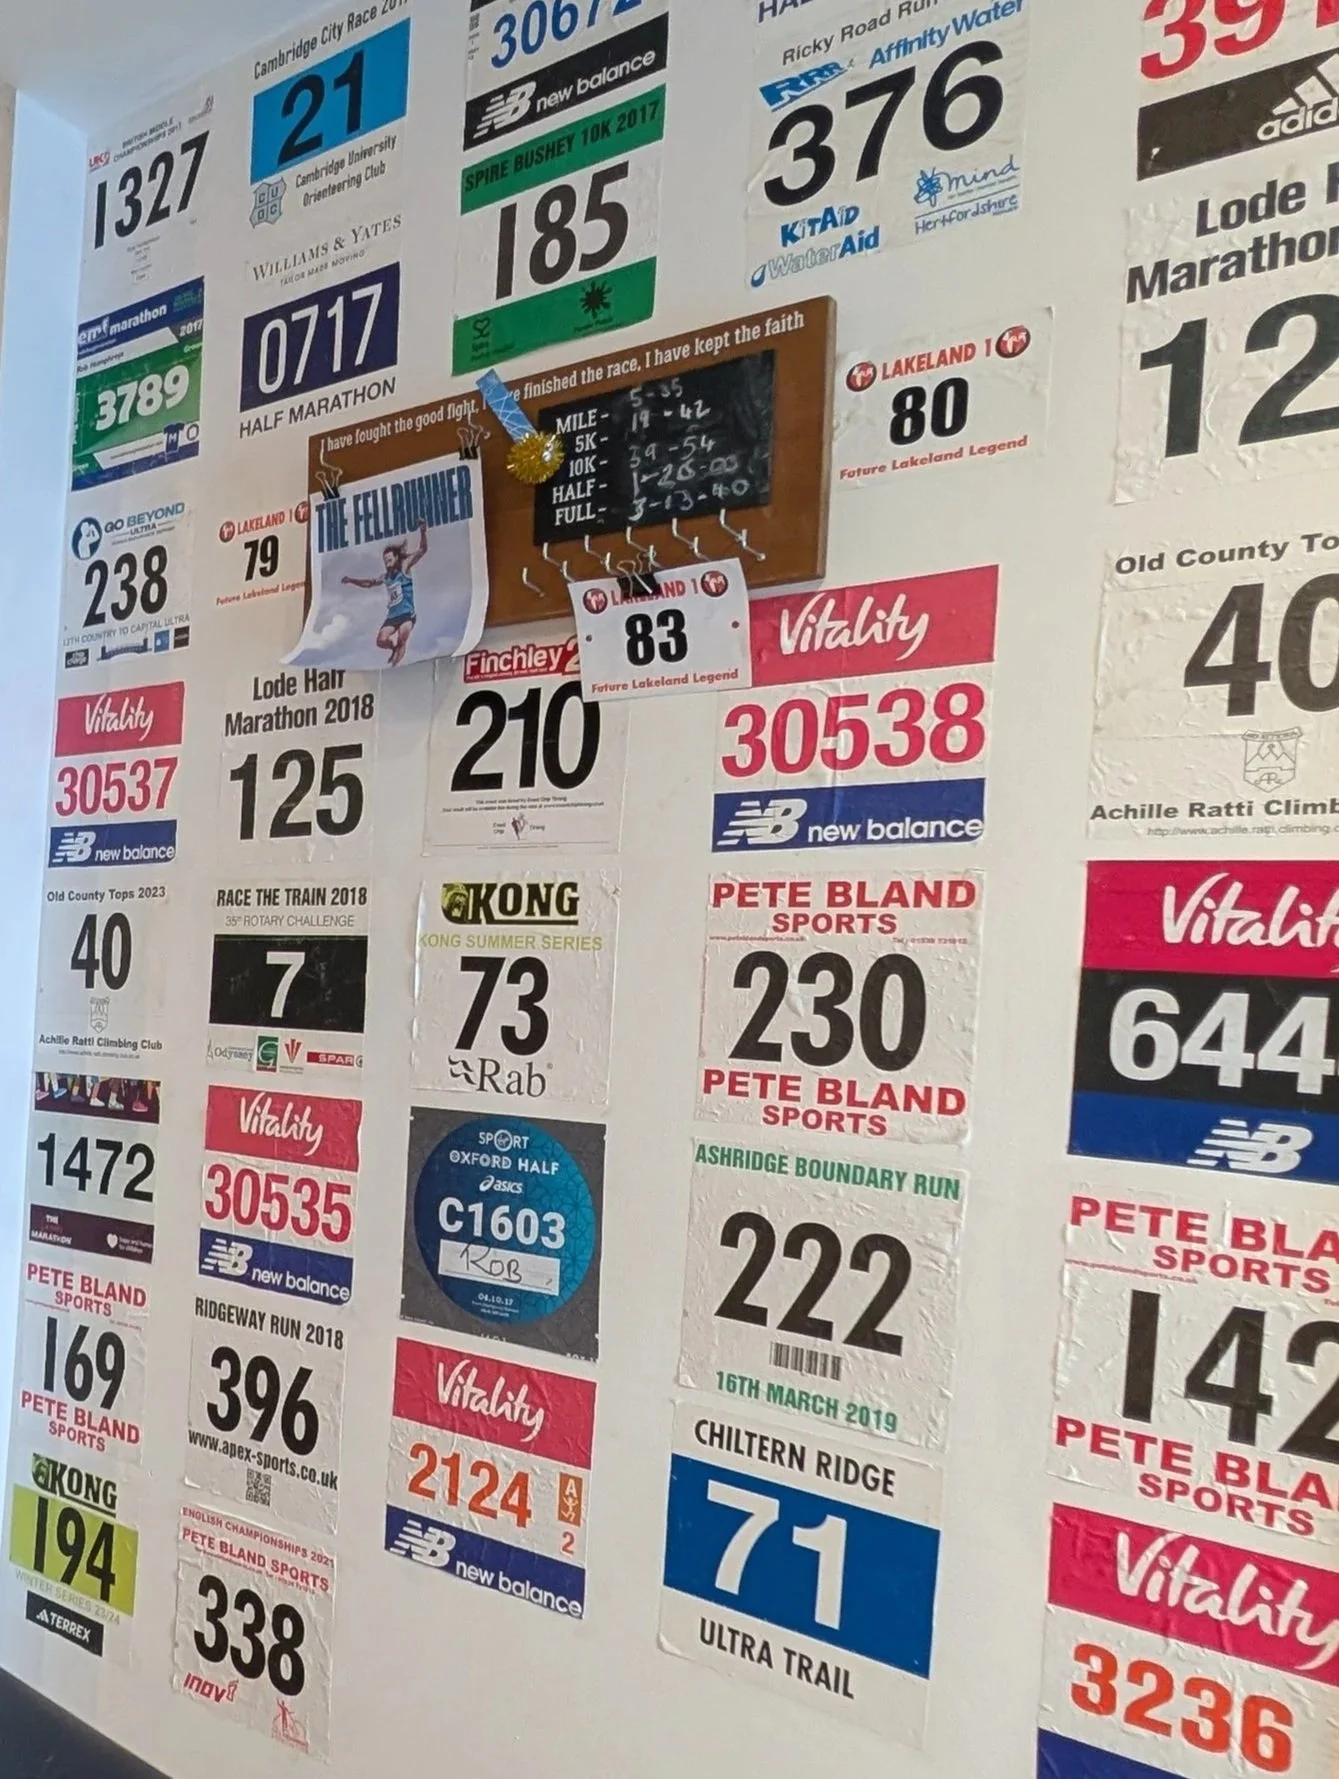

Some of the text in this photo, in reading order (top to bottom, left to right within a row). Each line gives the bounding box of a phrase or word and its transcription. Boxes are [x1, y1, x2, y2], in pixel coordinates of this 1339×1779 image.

[254, 6, 378, 80] Cambridge City Race
[782, 11, 890, 66] Ricky Road
[869, 24, 950, 69] Affinity
[277, 49, 364, 166] 21
[536, 51, 656, 112] new balance
[464, 102, 659, 193] SPIRE BUSHEY 10K 2017
[764, 40, 1004, 207] 376
[295, 133, 397, 189] Cambridge University
[303, 162, 386, 208] Orienteering Club
[946, 154, 1021, 191] mind
[93, 129, 210, 250] 1327
[914, 193, 1019, 236] Hertfordshire
[1196, 179, 1306, 238] Lode
[252, 214, 402, 282] WILLIAMS & YATES
[496, 160, 630, 300] 185
[279, 269, 305, 288] TAILOR
[109, 304, 167, 336] marathon
[179, 318, 203, 337] 2017
[258, 282, 383, 394] 0717
[327, 311, 805, 452] have fought the good fight, finished the race, have kept the faith
[882, 342, 977, 381] LAKELAND
[95, 364, 190, 432] 3789
[239, 376, 397, 439] HALF MARATHON
[890, 377, 969, 446] 80
[839, 435, 1028, 480] Future Lakeland Legend
[104, 502, 185, 533] GO BEYOND
[237, 511, 285, 535] LAKELAND
[315, 464, 474, 553] THE FELLRUNNER
[244, 535, 279, 581] 79
[1115, 541, 1289, 575] Old County
[83, 545, 168, 628] 238
[216, 595, 240, 605] Future
[81, 613, 190, 644] COUNTRY TO CAPITAL ULTRA
[625, 608, 688, 666] 83
[779, 592, 929, 662] Vitality
[253, 673, 297, 701] Lode
[465, 645, 563, 675] Finchley
[592, 668, 739, 693] Future Lakeland Legend
[85, 693, 154, 742] Vitality
[225, 693, 374, 737] Marathon 2018
[451, 680, 601, 792] 210
[721, 682, 986, 778] 30538
[55, 757, 178, 817] 30537
[230, 743, 363, 840] 125
[1090, 800, 1254, 820] Achille Ratti
[95, 845, 174, 862] new balance
[807, 816, 985, 843] new balance
[47, 886, 166, 903] Old County Tops 2023
[216, 887, 367, 907] RACE THE TRAIN 2018
[244, 915, 355, 927] ROTARY CHALLENGE
[712, 880, 976, 908] PETE BLAND
[71, 912, 132, 990] 40
[418, 934, 602, 951] KONG SUMMER SERIES
[772, 913, 898, 934] SPORTS
[266, 951, 306, 1018] 7
[455, 956, 549, 1055] 73
[728, 950, 926, 1071] 230
[39, 1034, 162, 1051] Achille Ratti Climbing Club
[318, 1054, 354, 1065] SPAR
[476, 1057, 546, 1098] Rab
[703, 1068, 966, 1116] PETE BLAND
[240, 1092, 324, 1156] Vitality
[762, 1105, 888, 1136] SPORTS
[37, 1132, 155, 1202] 1472
[449, 1150, 559, 1175] OXFORD HALF
[696, 1144, 960, 1200] ASHRIDGE BOUNDARY RUN
[205, 1164, 352, 1243] 30535
[438, 1197, 565, 1249] C1603
[1071, 1195, 1209, 1245] PETE
[27, 1263, 74, 1290] PETE
[80, 1274, 146, 1307] BLAND
[252, 1268, 351, 1301] new balance
[714, 1212, 911, 1356] 222
[1153, 1245, 1331, 1295] SPORTS
[55, 1291, 112, 1316] SPORTS
[195, 1297, 343, 1350] RIDGEWAY RUN 2018
[43, 1316, 125, 1410] 169
[1123, 1289, 1339, 1465] 142
[21, 1391, 140, 1444] PETE BLAND
[207, 1346, 319, 1456] 396
[438, 1359, 545, 1442] Vitality
[716, 1370, 898, 1434] 16TH MARCH 2019
[49, 1421, 105, 1451] SPORTS
[188, 1429, 338, 1490] www.apex-sports.co.uk
[694, 1419, 896, 1497] CHILTERN RIDGE
[1056, 1415, 1193, 1476] PETE
[408, 1442, 532, 1528] 2124
[1139, 1472, 1316, 1537] SPORTS
[33, 1496, 116, 1603] 194
[182, 1507, 308, 1558] ENGLISH CHAMPIONSHIPS
[182, 1527, 215, 1550] PETE
[219, 1540, 266, 1568] BLAND
[271, 1559, 329, 1592] SPORTS
[561, 1532, 575, 1555] 2
[707, 1479, 847, 1630] 71
[456, 1560, 494, 1586] new
[50, 1612, 91, 1643] TERREX
[194, 1574, 305, 1697] 338
[700, 1616, 855, 1700] ULTRA TRAIL
[1071, 1642, 1294, 1772] 3236
